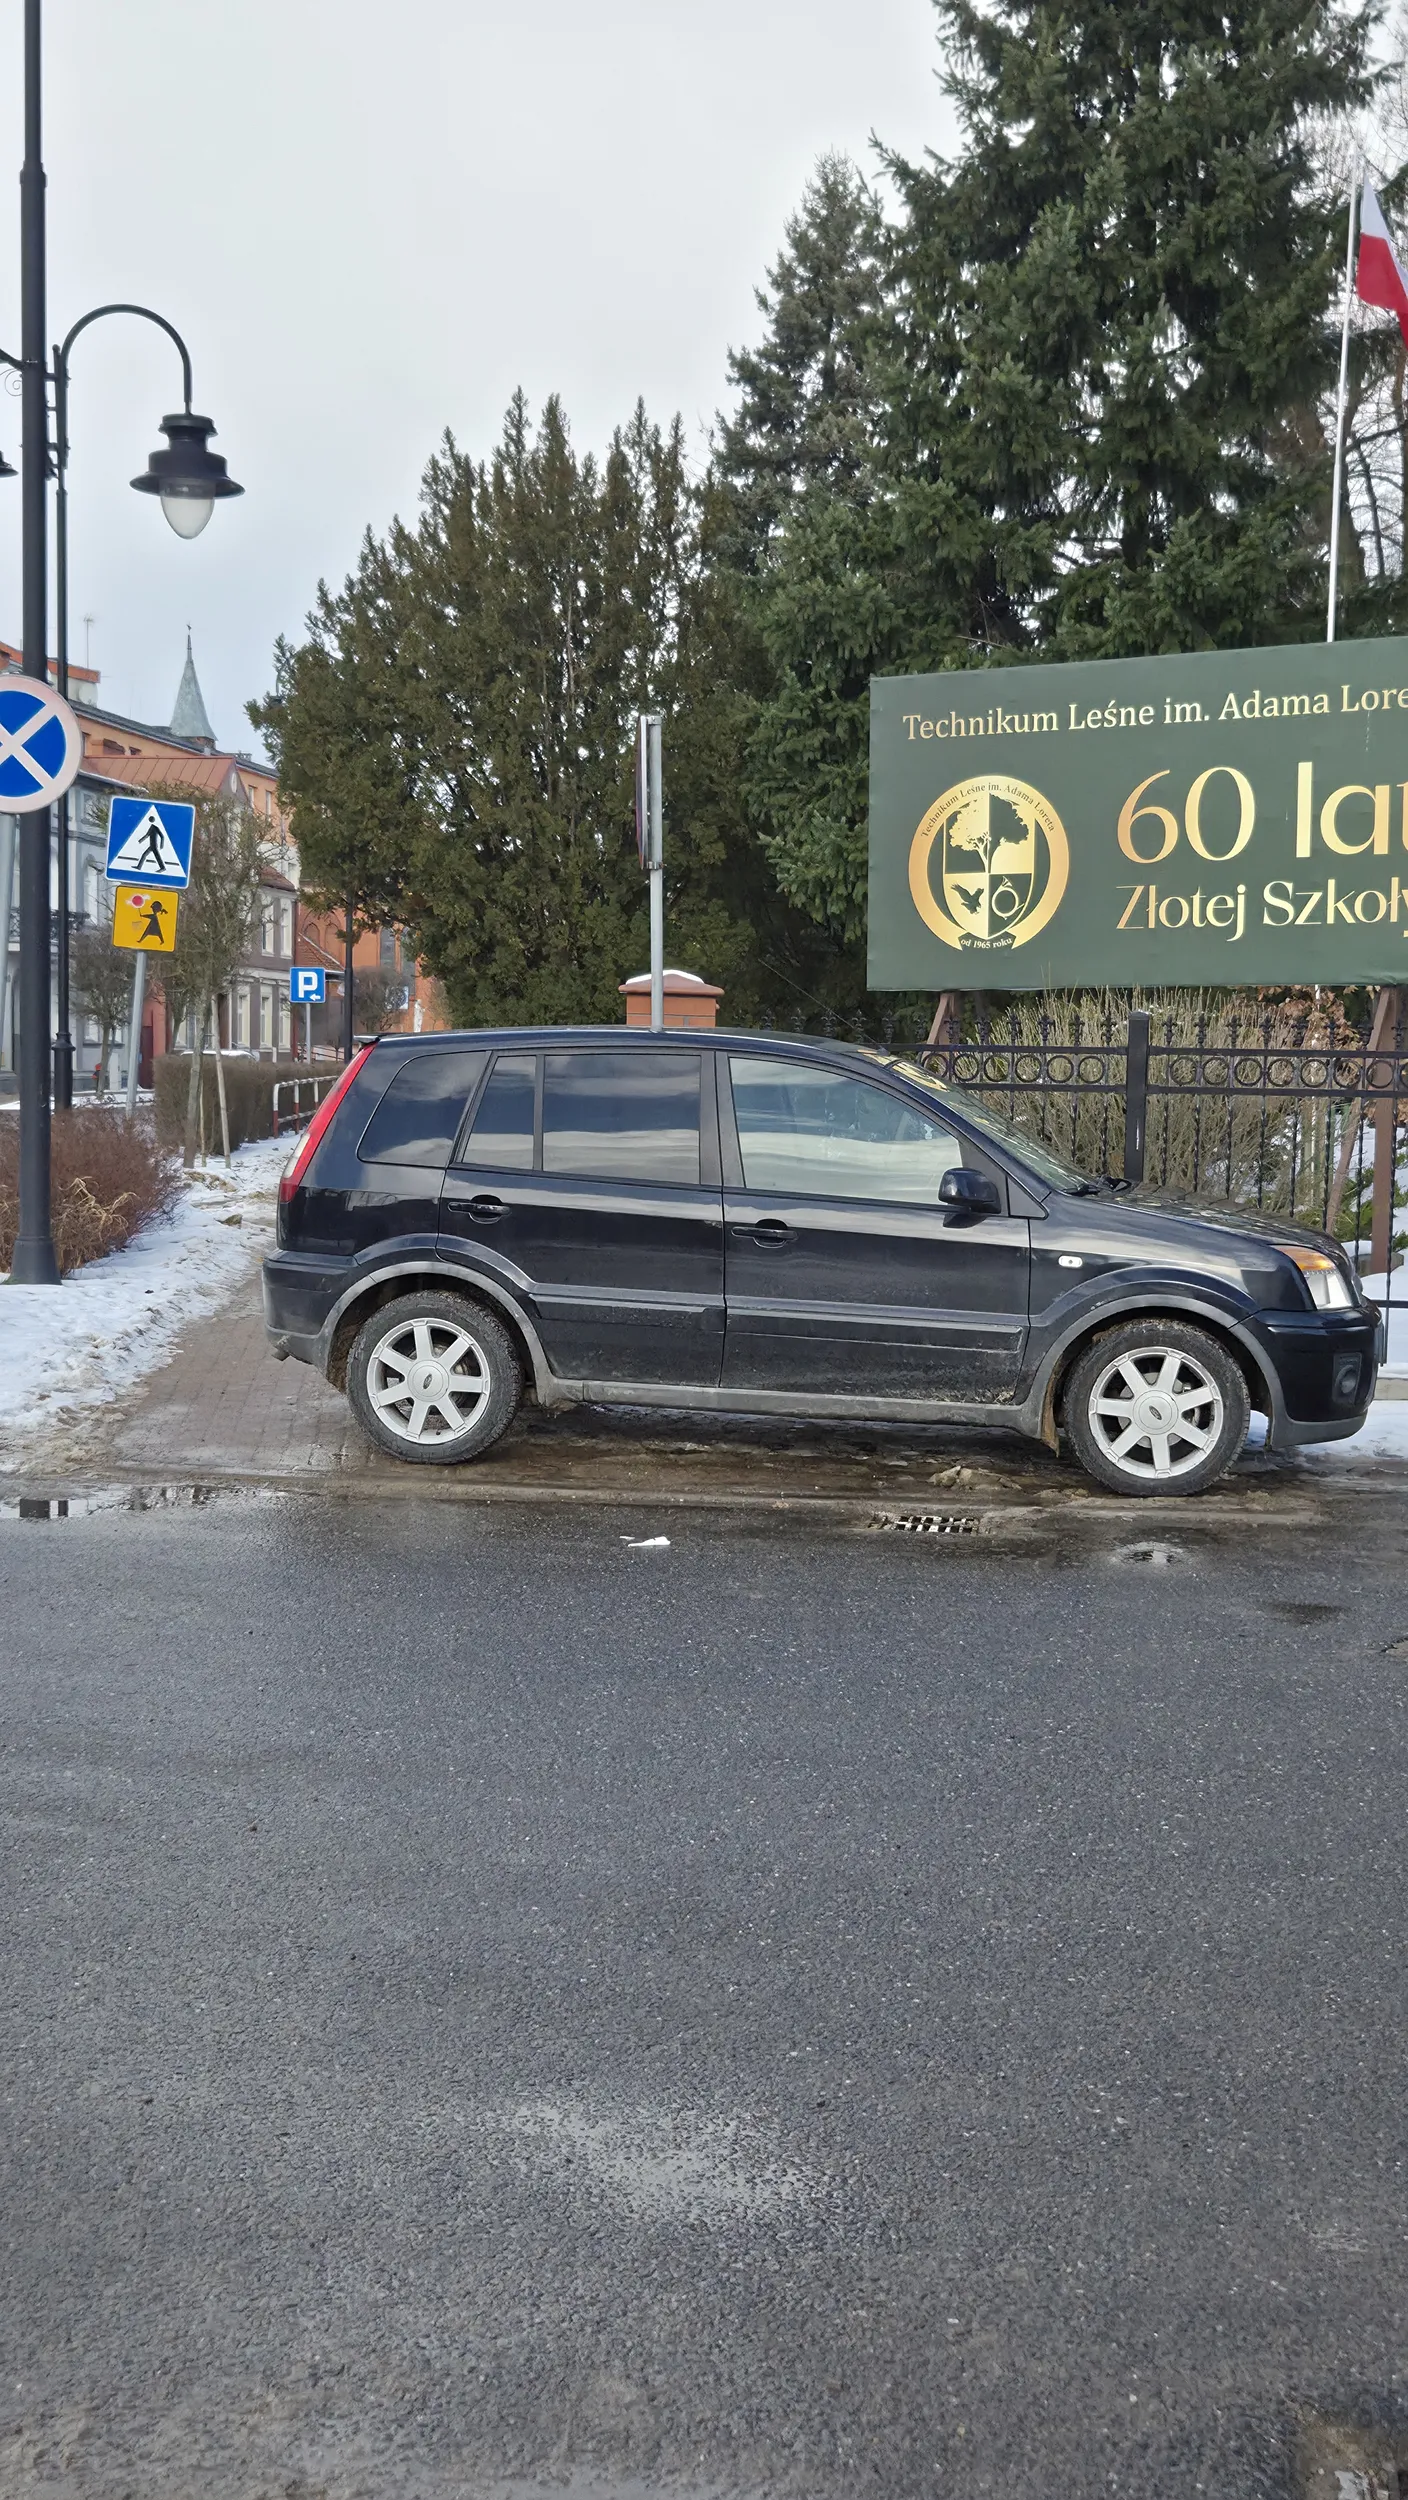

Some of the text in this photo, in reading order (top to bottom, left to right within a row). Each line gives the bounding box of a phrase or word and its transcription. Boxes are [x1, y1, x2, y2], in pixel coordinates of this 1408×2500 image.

[902, 708, 1058, 740] Technikum
[1068, 699, 1155, 731] Leśne
[1164, 698, 1209, 723] im.
[1220, 690, 1330, 721] Adama
[921, 781, 1056, 838] Technikum Leśne im. Adama Loreta
[1116, 766, 1256, 864] 60
[1115, 884, 1247, 943] Złotej
[960, 938, 1013, 949] od 1965 roku
[298, 971, 318, 998] P
